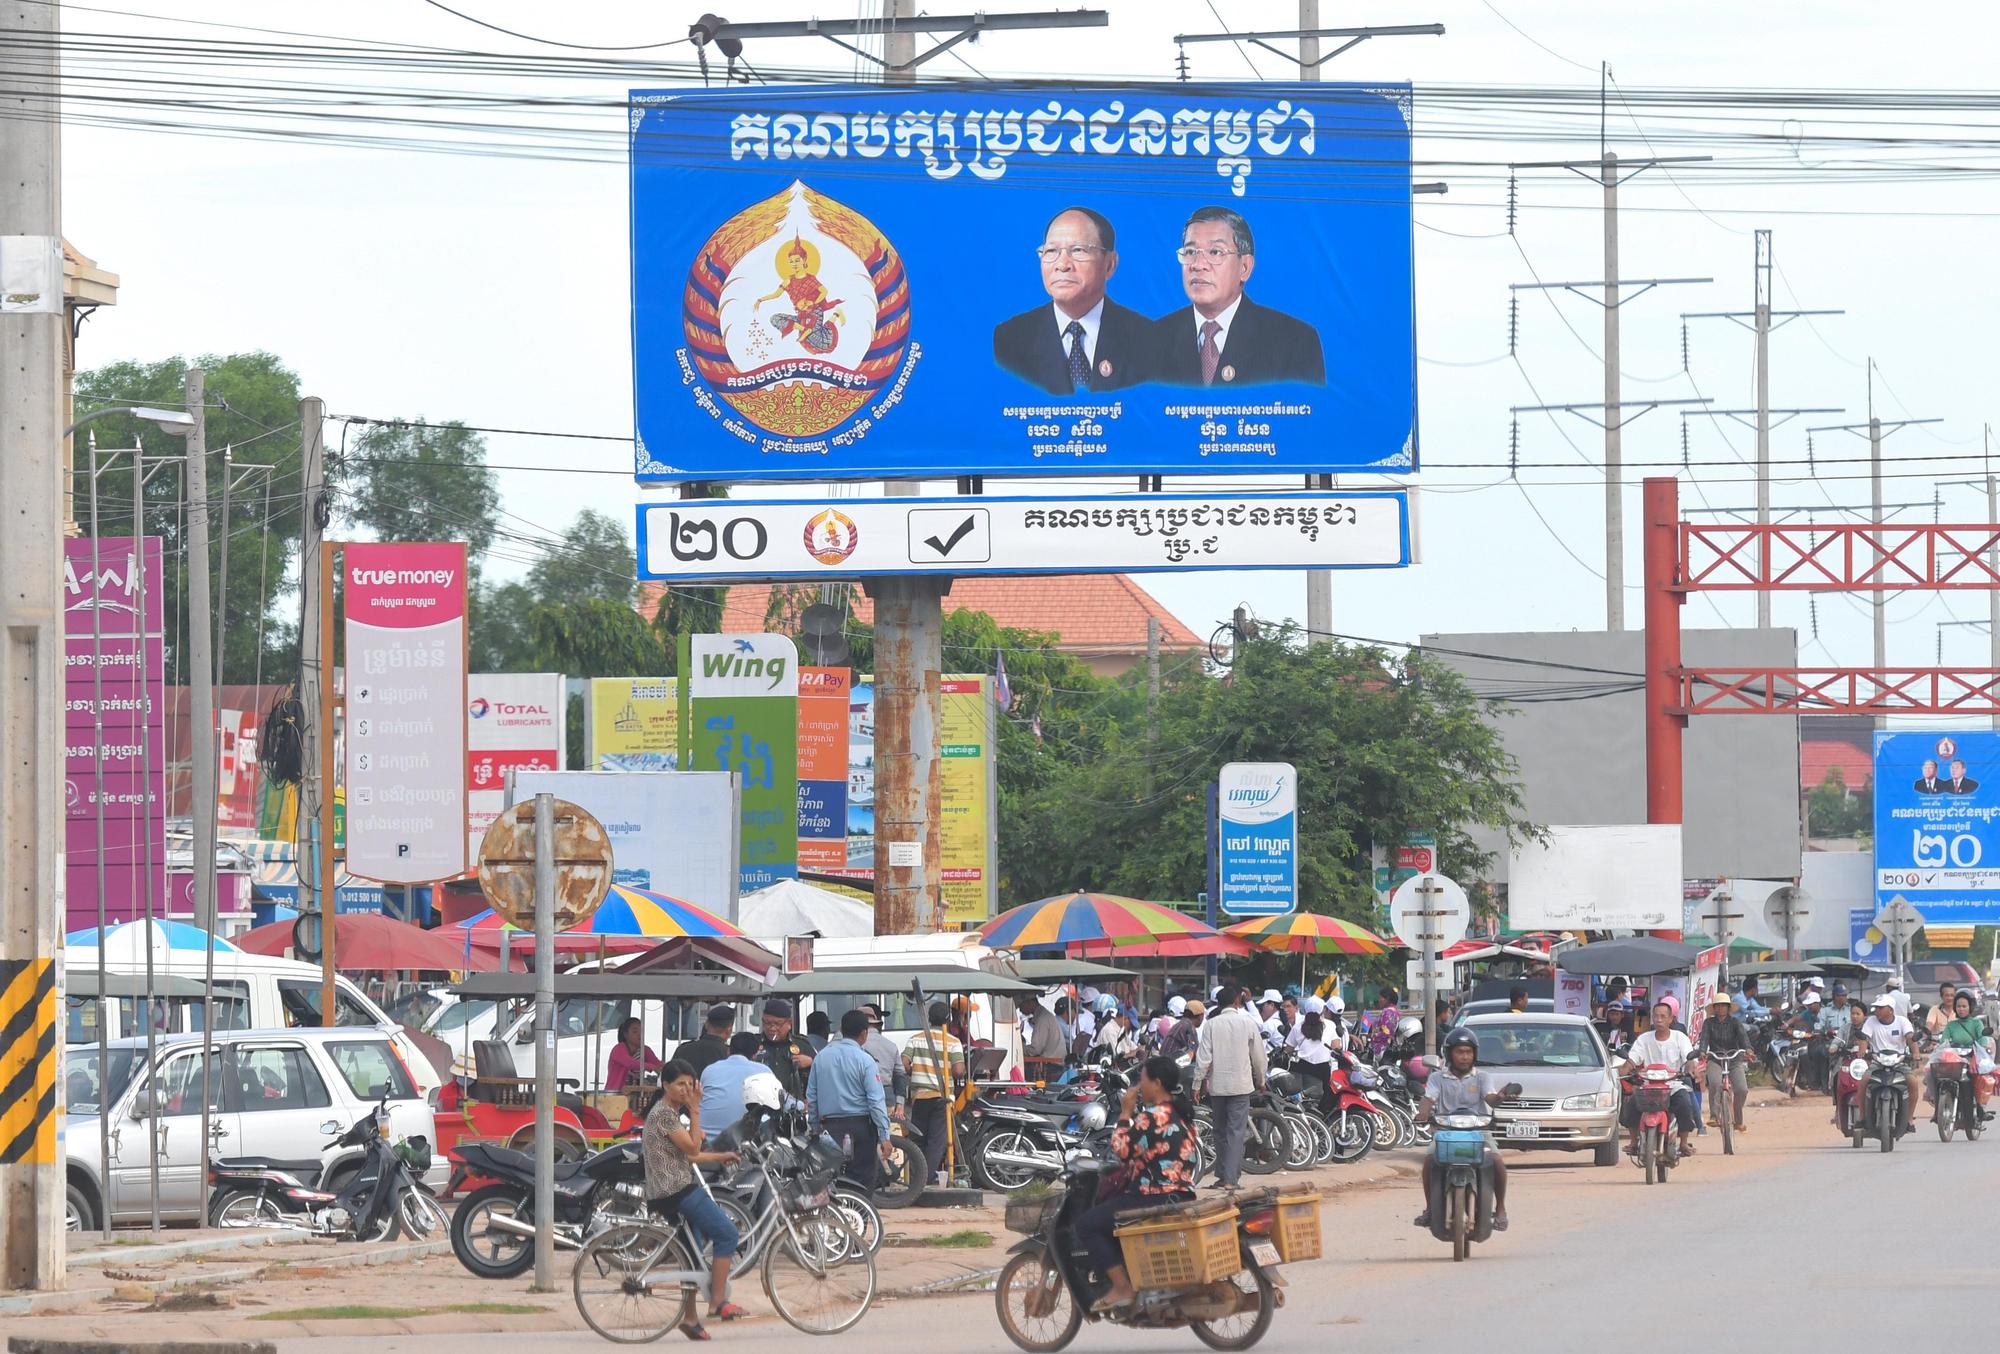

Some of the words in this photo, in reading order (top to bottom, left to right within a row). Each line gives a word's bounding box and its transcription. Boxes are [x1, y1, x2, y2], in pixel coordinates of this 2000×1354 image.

[730, 100, 1316, 197] គណបក្សប្រជាជនកម្ពុជា
[727, 361, 868, 390] គណបក្សប្រជាជនកម្ពុជា
[1027, 423, 1060, 437] ហេង
[1237, 421, 1270, 437] សែន
[1198, 441, 1277, 457] ប្រធានគណបក្ស
[669, 511, 769, 561] ២០
[1023, 503, 1358, 543] គណបក្សប្រជាជនកម្ពុជា
[702, 653, 786, 691] Wing
[494, 702, 549, 715] TOTAL
[497, 718, 552, 727] LUBRICANTS
[1912, 829, 1982, 868] ២០
